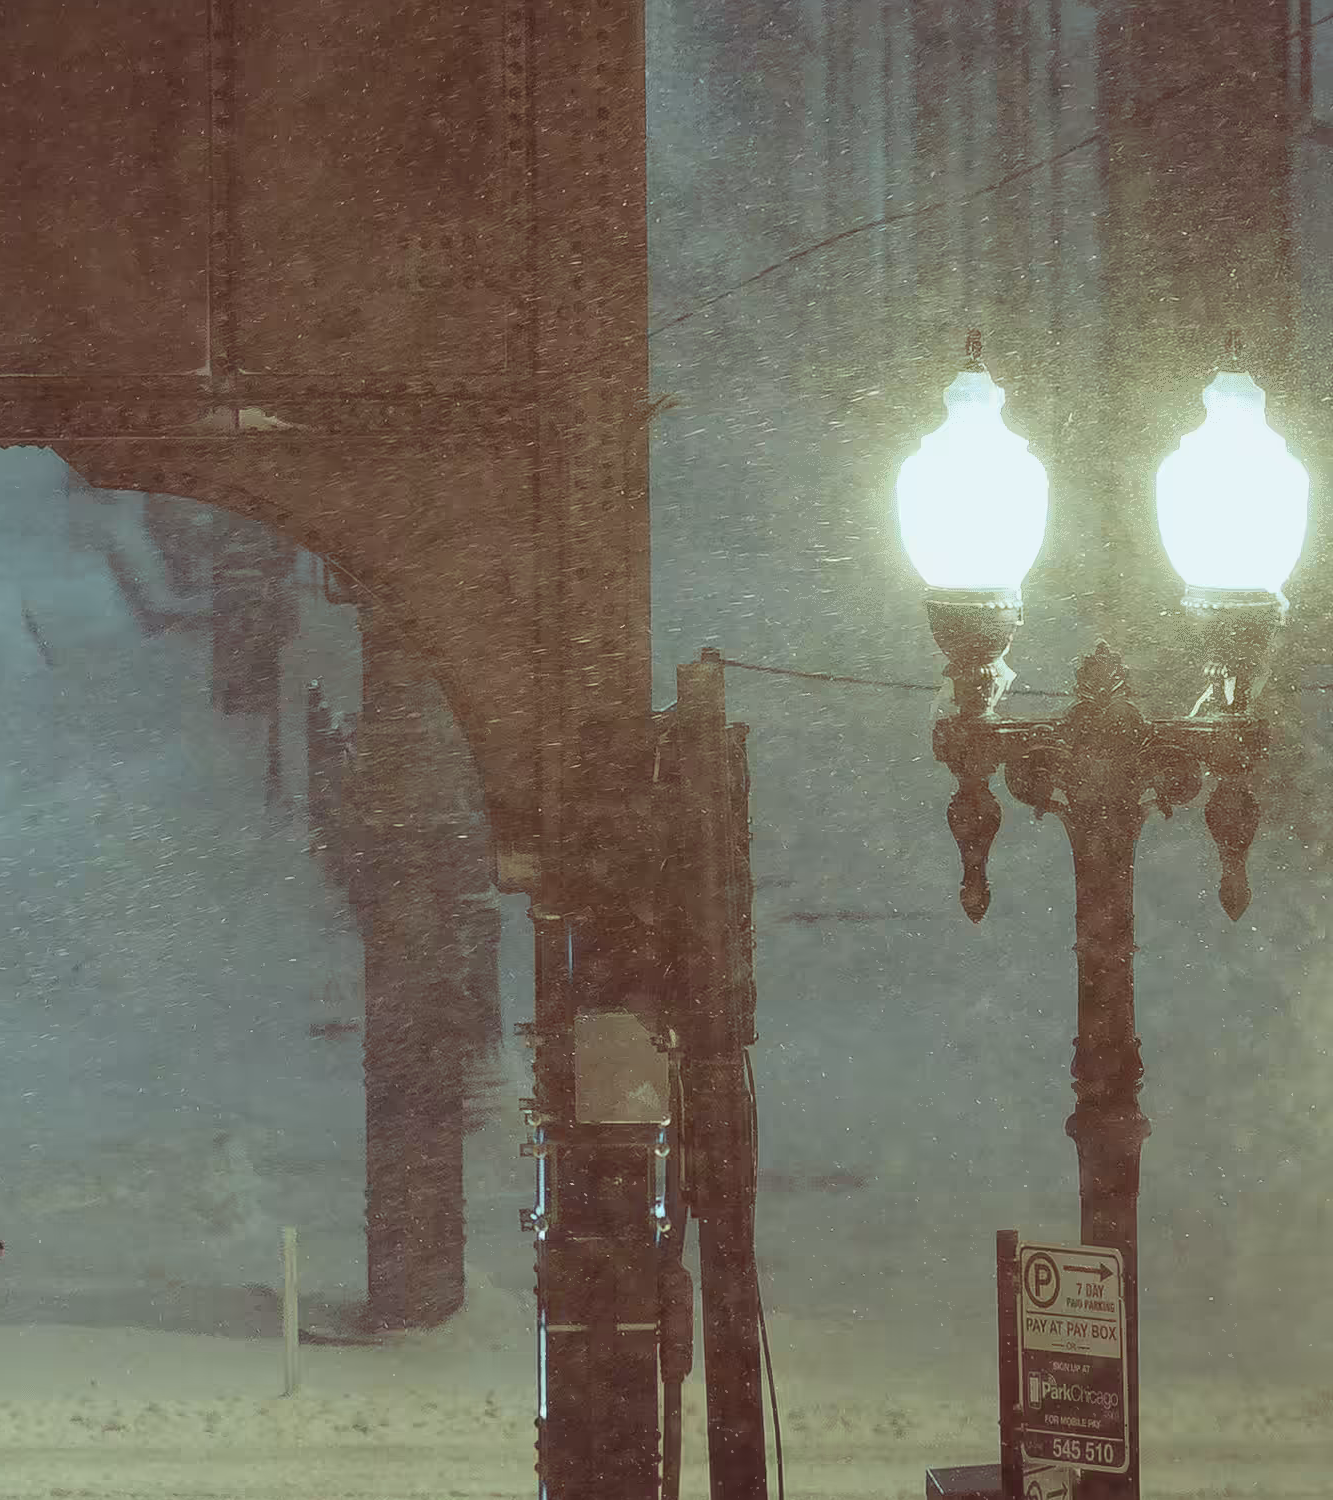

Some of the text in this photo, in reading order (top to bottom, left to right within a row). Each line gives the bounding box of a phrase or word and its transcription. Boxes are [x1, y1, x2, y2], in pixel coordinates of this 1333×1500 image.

[1076, 1282, 1104, 1298] 7 DAY
[1084, 1300, 1115, 1313] PARKING
[1027, 1318, 1117, 1341] PAY AT PAY BOX
[1053, 1361, 1069, 1371] SIGN
[1042, 1381, 1118, 1410] ParkChicago
[1044, 1414, 1101, 1430] FOR MOBILE PAY
[1053, 1438, 1081, 1460] 545
[1085, 1441, 1113, 1464] 510
